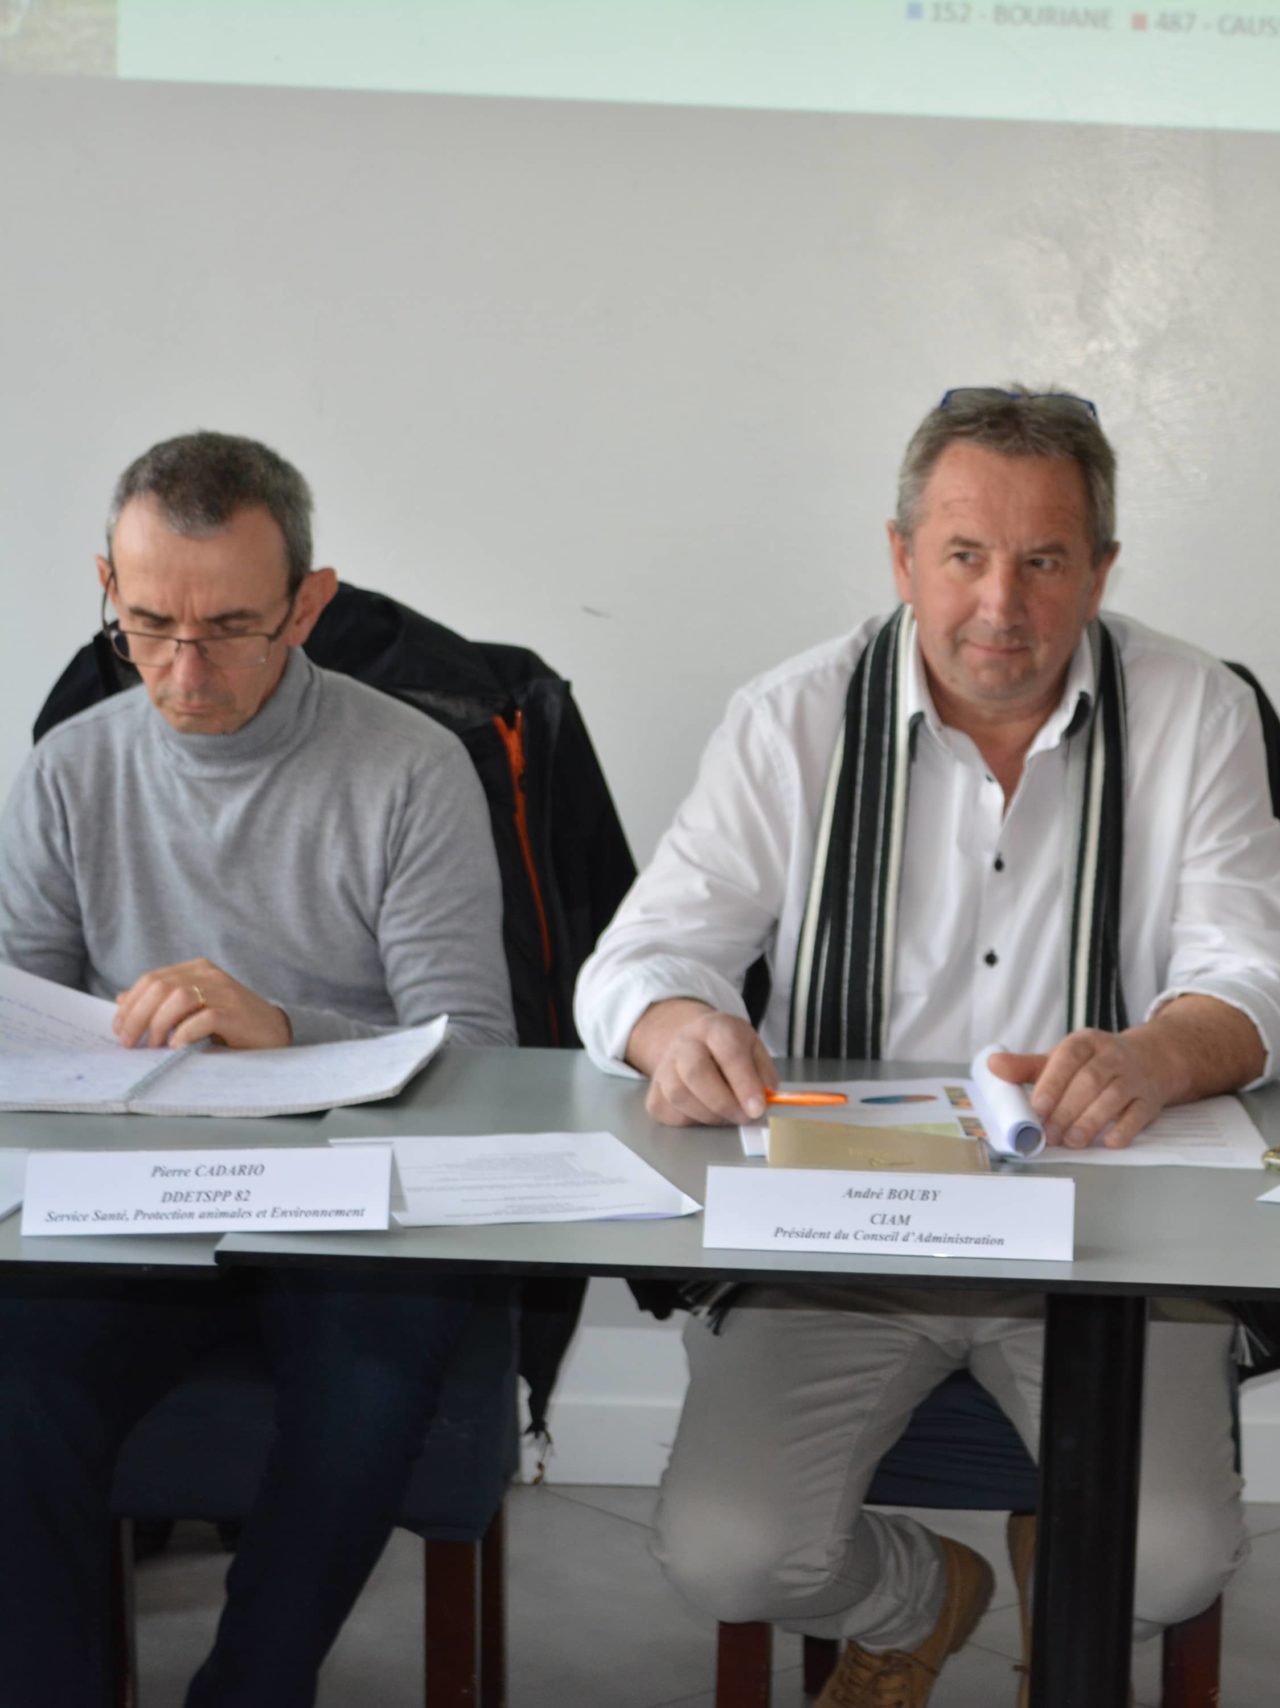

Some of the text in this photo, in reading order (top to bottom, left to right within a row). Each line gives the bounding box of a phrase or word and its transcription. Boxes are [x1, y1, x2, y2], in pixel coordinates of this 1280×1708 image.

[993, 4, 1110, 31] BOURIANE
[151, 1164, 265, 1177] Pierre CADARIO
[161, 1190, 251, 1203] DDETSPP 82
[843, 1188, 941, 1201] André BOUBY
[45, 1207, 365, 1222] Service Santé, Protection animales et Environnement
[870, 1213, 911, 1226] CIAM
[774, 1227, 831, 1239] Président
[833, 1229, 849, 1240] du
[853, 1230, 899, 1242] Conseil
